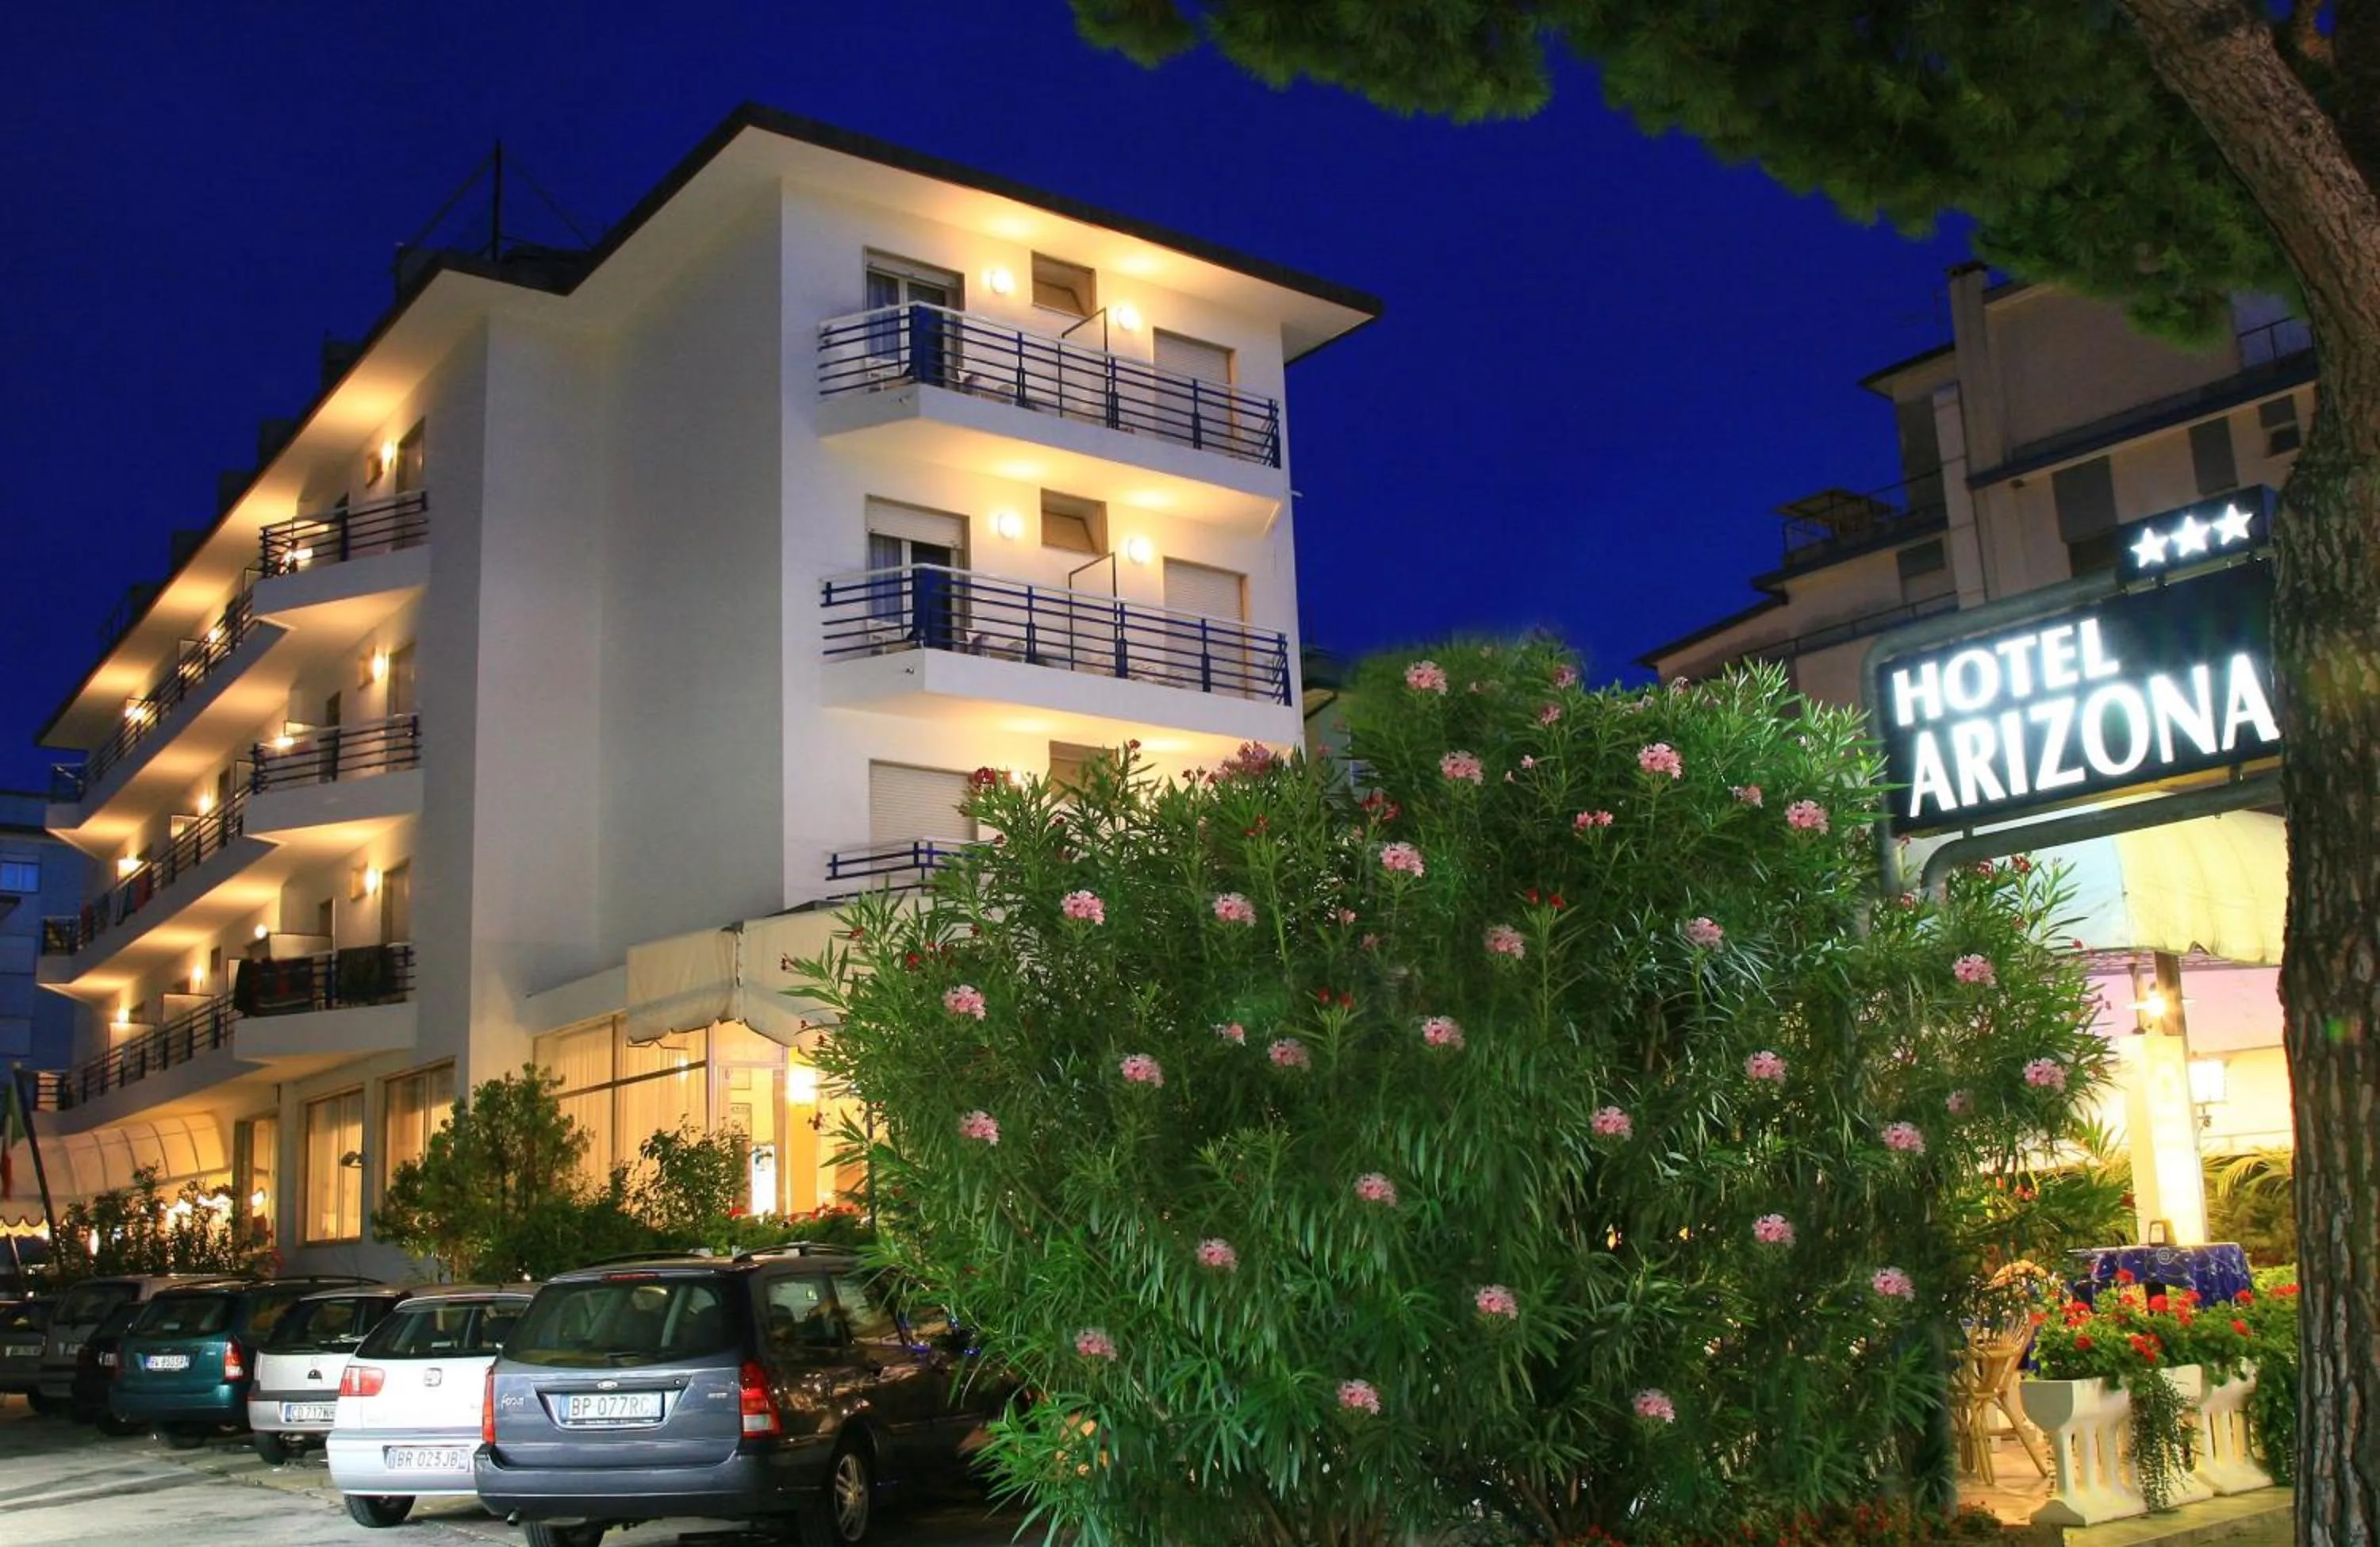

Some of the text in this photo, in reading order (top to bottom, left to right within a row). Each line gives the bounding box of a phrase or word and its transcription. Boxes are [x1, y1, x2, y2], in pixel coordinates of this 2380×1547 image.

[1892, 617, 2121, 727] HOTEL
[1909, 652, 2282, 819] ARIZONA
[571, 1398, 591, 1416] BP
